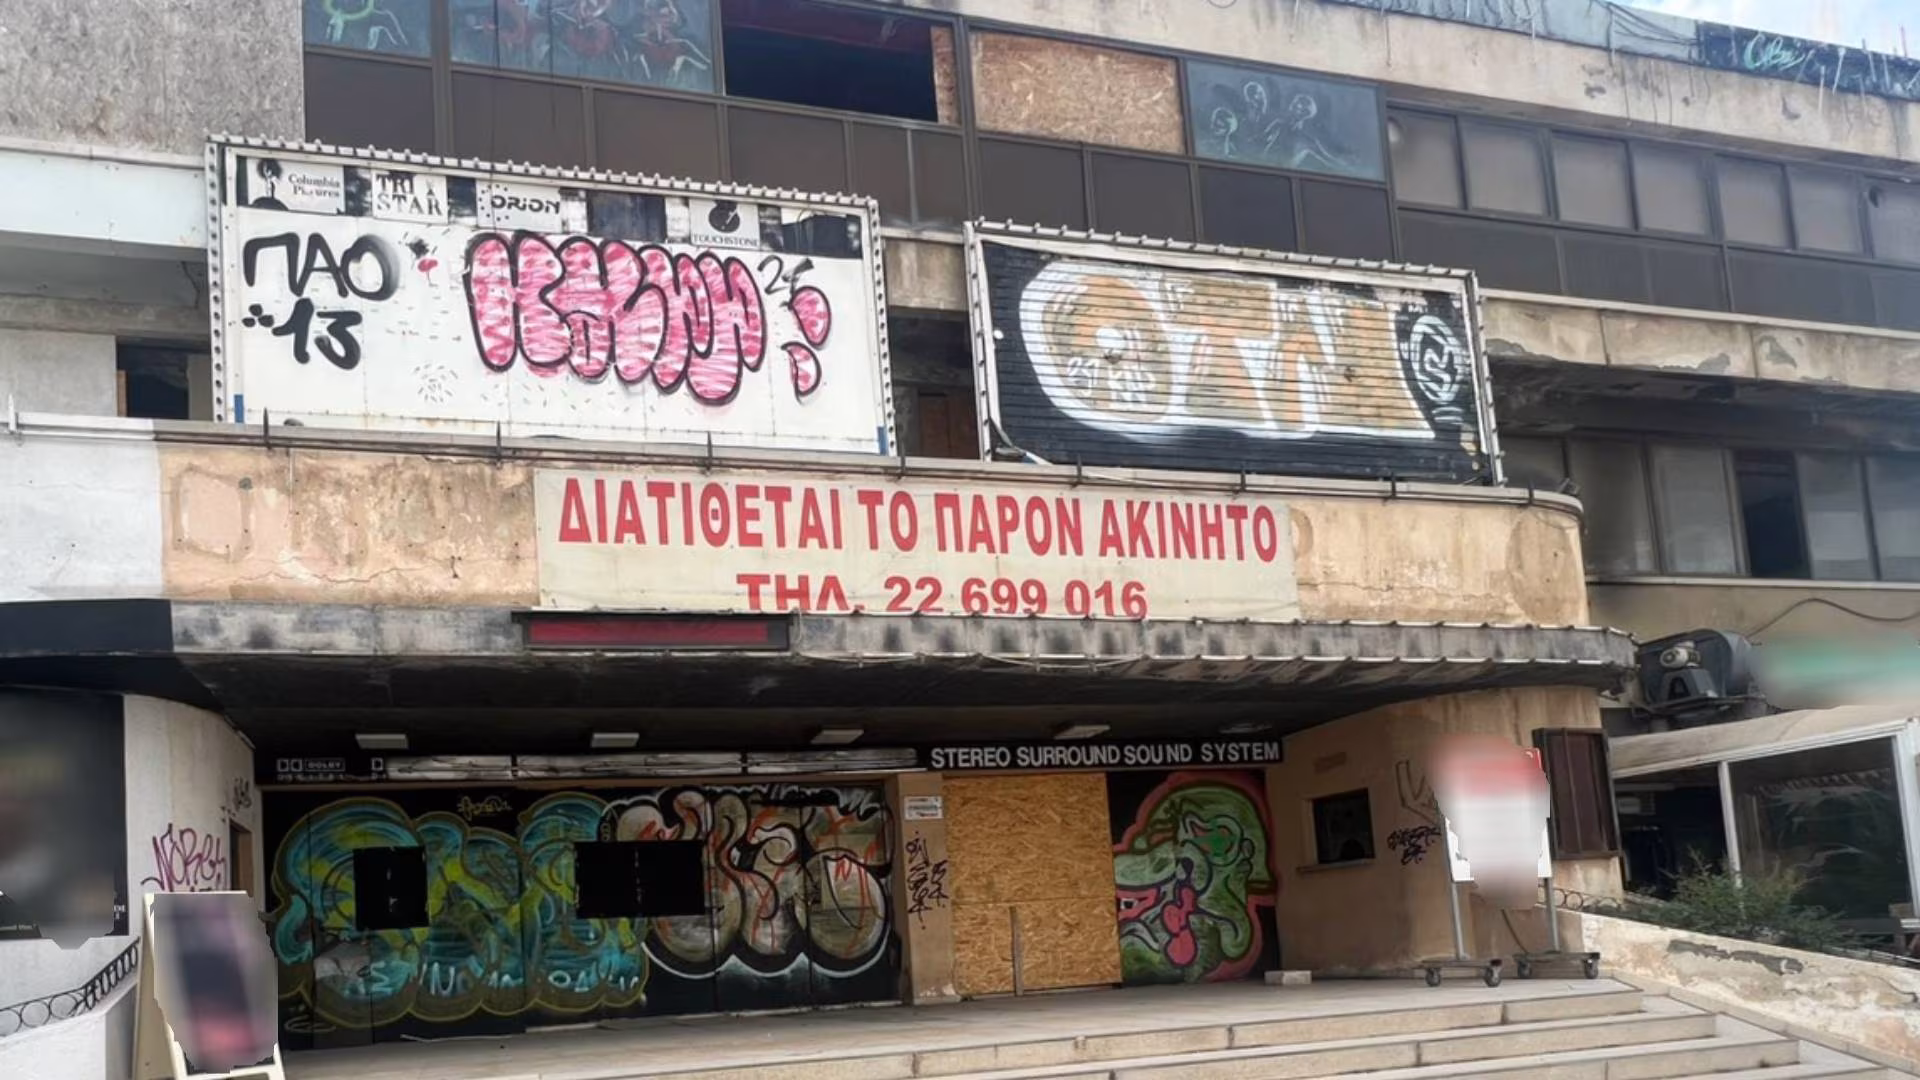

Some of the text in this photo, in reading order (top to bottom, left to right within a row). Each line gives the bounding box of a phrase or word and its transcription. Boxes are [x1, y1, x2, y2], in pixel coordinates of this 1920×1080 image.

[288, 174, 341, 189] Columbia
[376, 174, 415, 195] TRI
[377, 192, 443, 216] STAR
[271, 297, 363, 370] 13
[558, 477, 1278, 562] ΔΙΑΤΙΘΕΤΑΙ ΤΟ ΠΑΡΟΝ ΑΚΙΝΗΤΟ
[884, 575, 944, 613] 22
[960, 577, 1048, 615] 699
[1064, 579, 1148, 619] 016
[931, 741, 1280, 768] STEREO SURROUND SOUND SYSTEM
